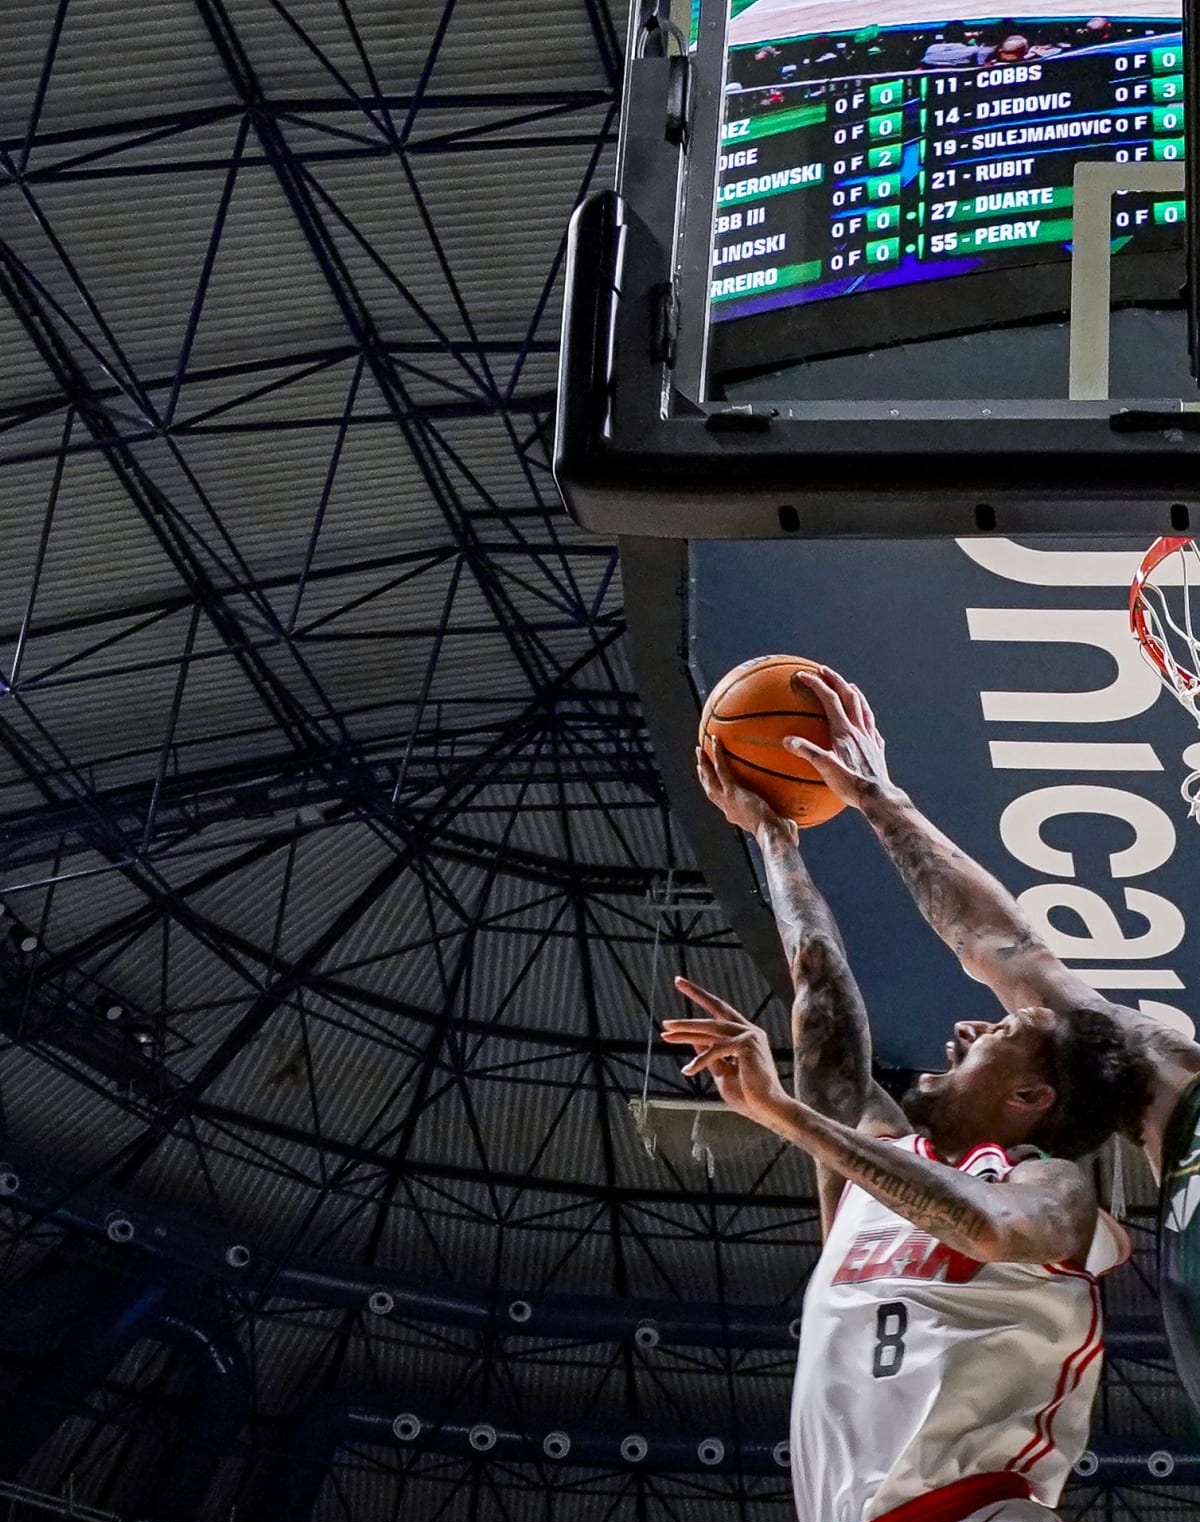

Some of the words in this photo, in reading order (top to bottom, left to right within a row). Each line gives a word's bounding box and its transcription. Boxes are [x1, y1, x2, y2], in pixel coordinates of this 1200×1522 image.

[935, 77, 957, 95] 11
[977, 65, 1042, 88] COBBS
[1115, 57, 1128, 72] 0
[1134, 54, 1146, 69] F
[1163, 53, 1176, 67] 0
[835, 99, 847, 113] 0
[852, 94, 865, 108] F
[880, 88, 893, 103] 0
[934, 107, 960, 126] 14
[976, 92, 1072, 120] DJEDOVIC
[1115, 87, 1128, 101] 0
[1135, 85, 1147, 99] F
[1163, 83, 1176, 98] 3
[834, 129, 846, 144] 0
[852, 125, 864, 140] F
[879, 120, 892, 135] 0
[933, 139, 957, 157] 19
[972, 118, 1112, 150] SULEJMANOVIC
[834, 160, 846, 175] 0
[851, 156, 864, 170] F
[878, 151, 891, 167] 2
[931, 169, 956, 190] 21
[976, 158, 1035, 182] RUBIT
[930, 201, 957, 221] 27
[975, 187, 1054, 213] DUARTE
[930, 232, 957, 253] 55
[975, 220, 1041, 245] PERRY
[872, 1301, 909, 1379] 8
